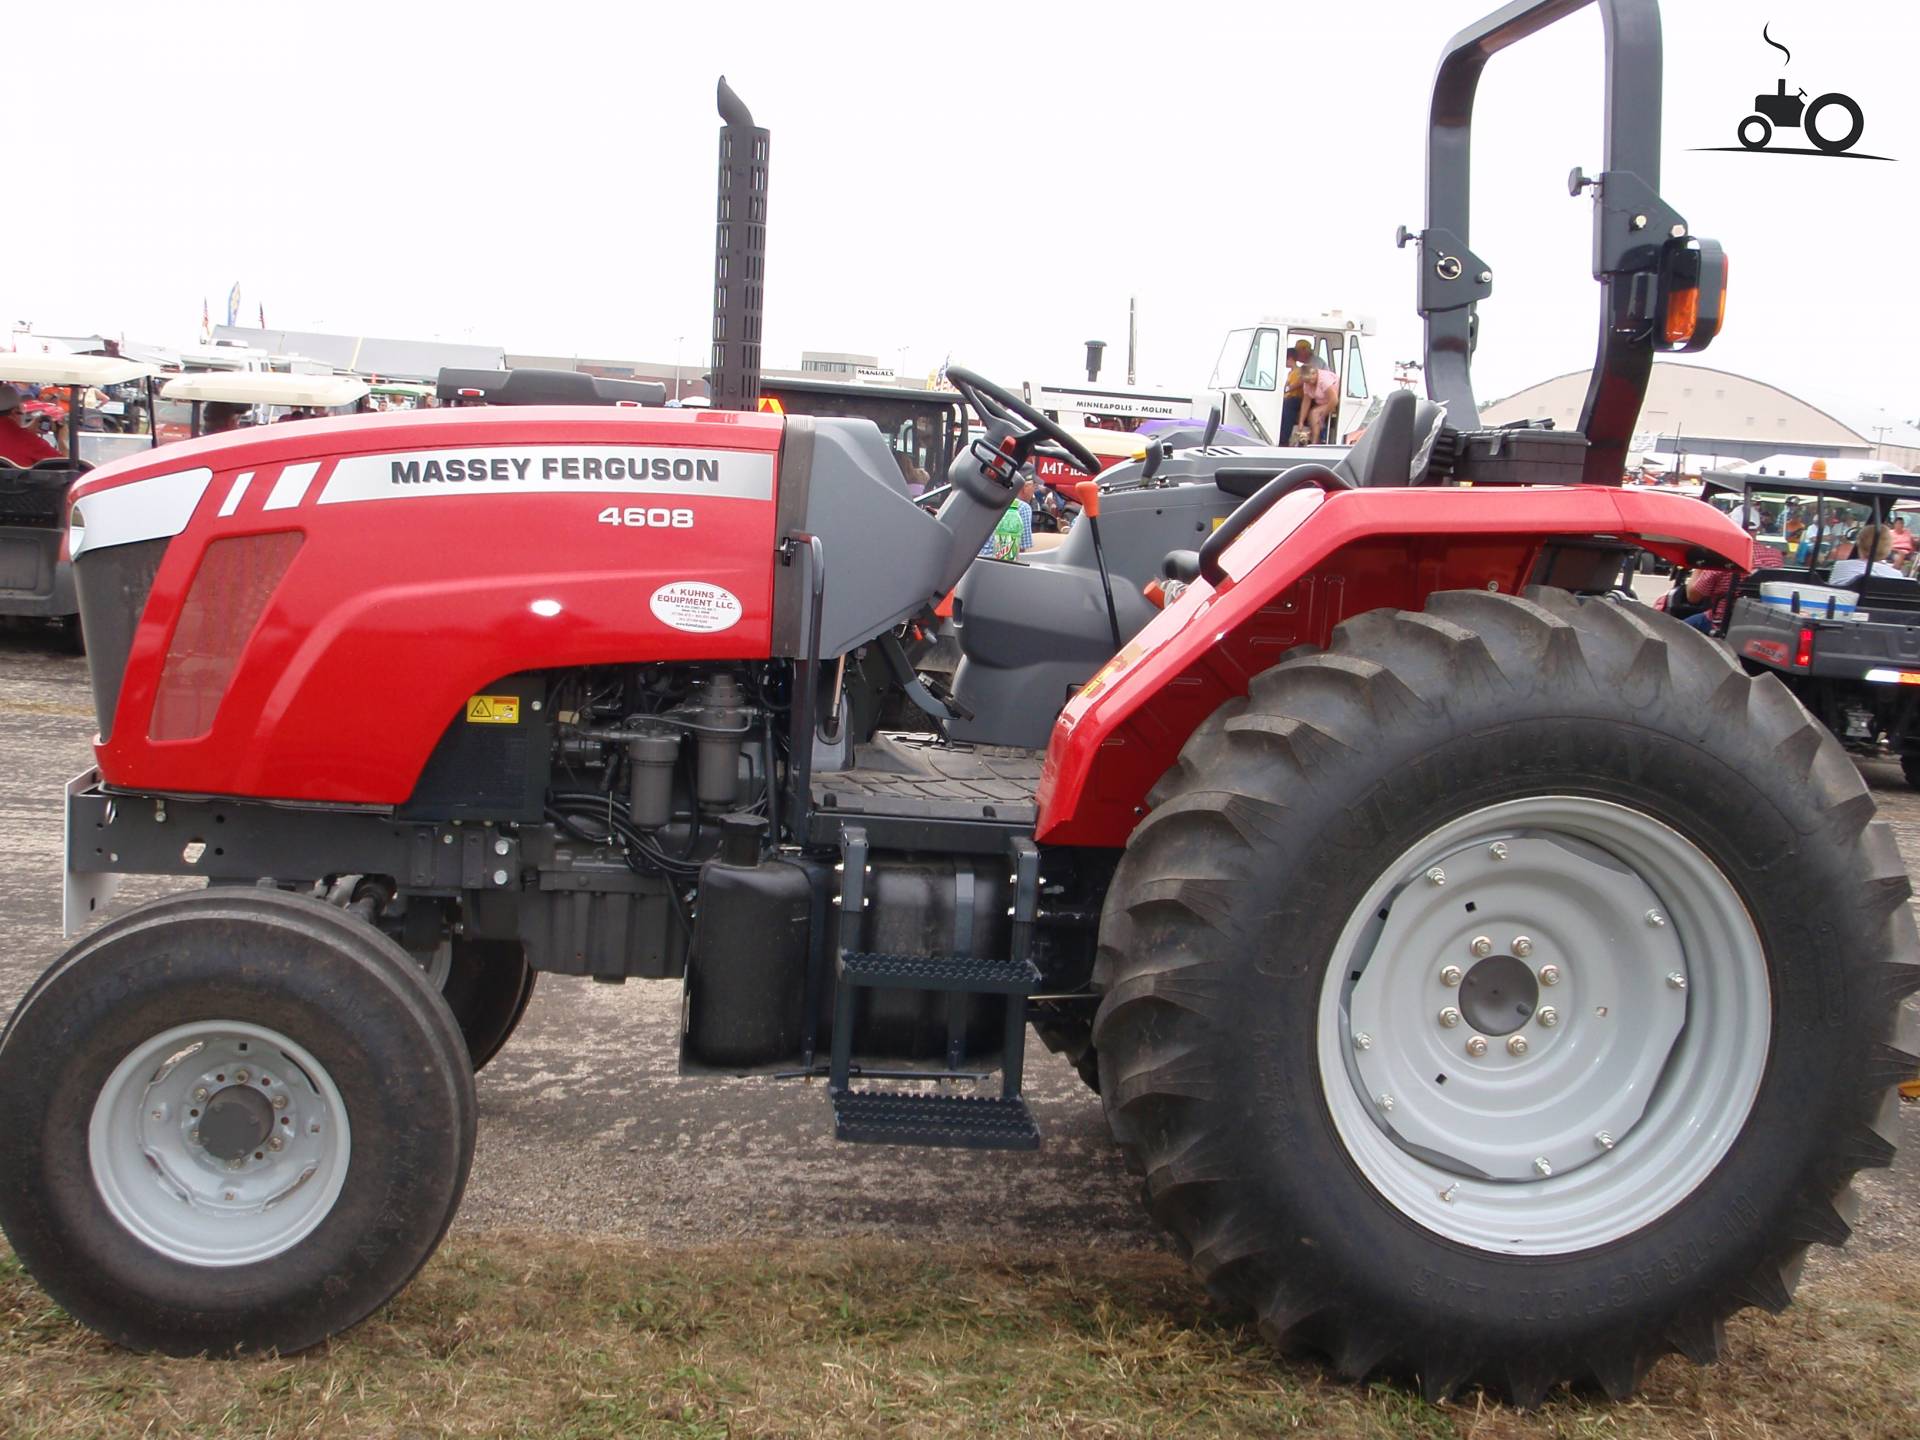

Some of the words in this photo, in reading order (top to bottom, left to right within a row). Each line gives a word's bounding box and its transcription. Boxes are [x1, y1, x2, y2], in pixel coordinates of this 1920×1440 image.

[857, 369, 894, 377] MANUALS
[1076, 401, 1133, 411] MINNEAPOLIS
[1141, 406, 1173, 414] MOLINE
[391, 458, 532, 484] MASSEY
[542, 457, 719, 482] FERGUSON
[598, 507, 694, 528] 4608
[680, 588, 715, 599] KUHNS
[657, 594, 712, 607] EQUIPMENT
